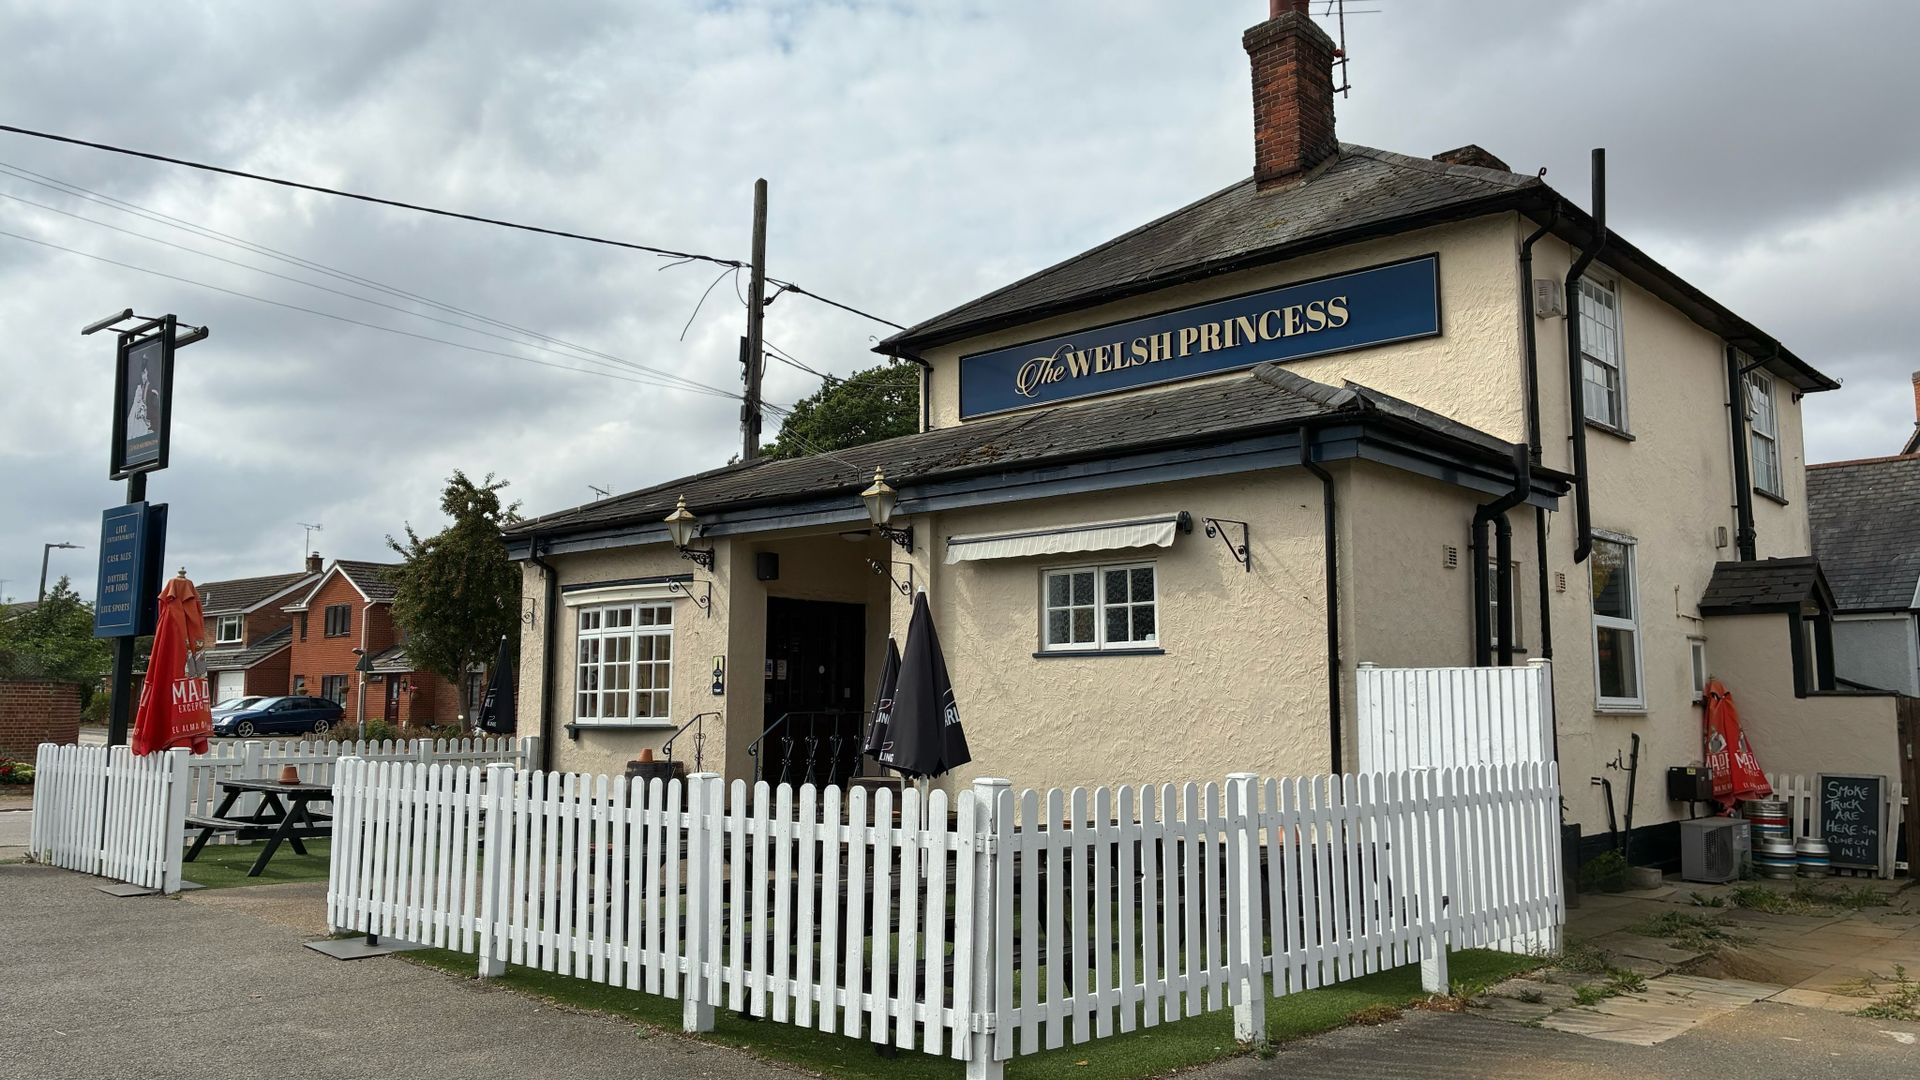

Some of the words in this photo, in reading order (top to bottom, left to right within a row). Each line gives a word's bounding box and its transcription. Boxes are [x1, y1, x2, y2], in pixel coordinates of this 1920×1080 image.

[1014, 343, 1074, 398] The
[1065, 331, 1173, 378] WELSH
[1178, 296, 1349, 358] PRINCESS
[107, 553, 119, 563] CASK
[120, 551, 132, 561] ALES
[115, 582, 129, 591] FOOD
[111, 602, 130, 612] SPORTS
[1826, 781, 1869, 800] SMOKE
[1825, 798, 1865, 812] TRUCK
[1835, 810, 1860, 820] ARE
[1826, 820, 1858, 835] HERE
